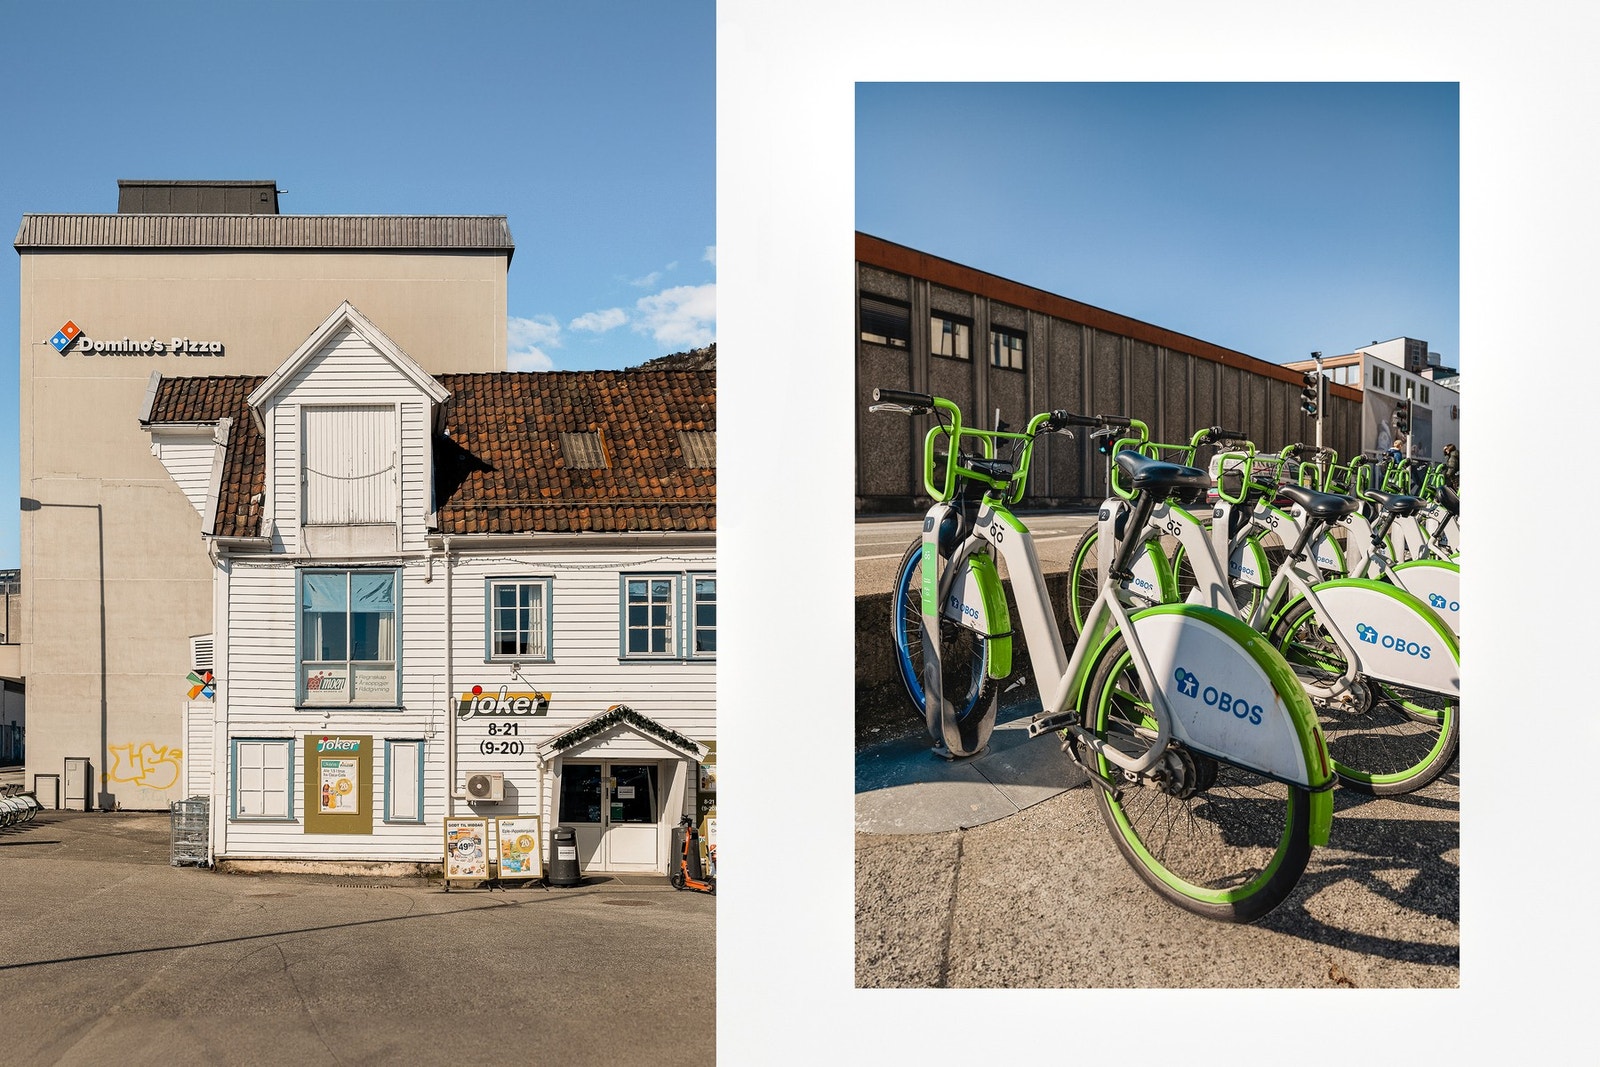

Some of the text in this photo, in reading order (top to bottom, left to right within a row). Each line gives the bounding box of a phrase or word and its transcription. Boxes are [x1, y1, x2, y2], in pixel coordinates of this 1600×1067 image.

[79, 336, 222, 353] Domino's Pizza
[1237, 565, 1255, 577] OBOS
[960, 603, 980, 620] OBOS
[1381, 635, 1432, 660] OBOS
[461, 685, 545, 721] joker
[1203, 686, 1264, 726] OBOS
[488, 722, 519, 736] 8-21
[318, 736, 360, 752] joker
[480, 740, 525, 756] (9-20)
